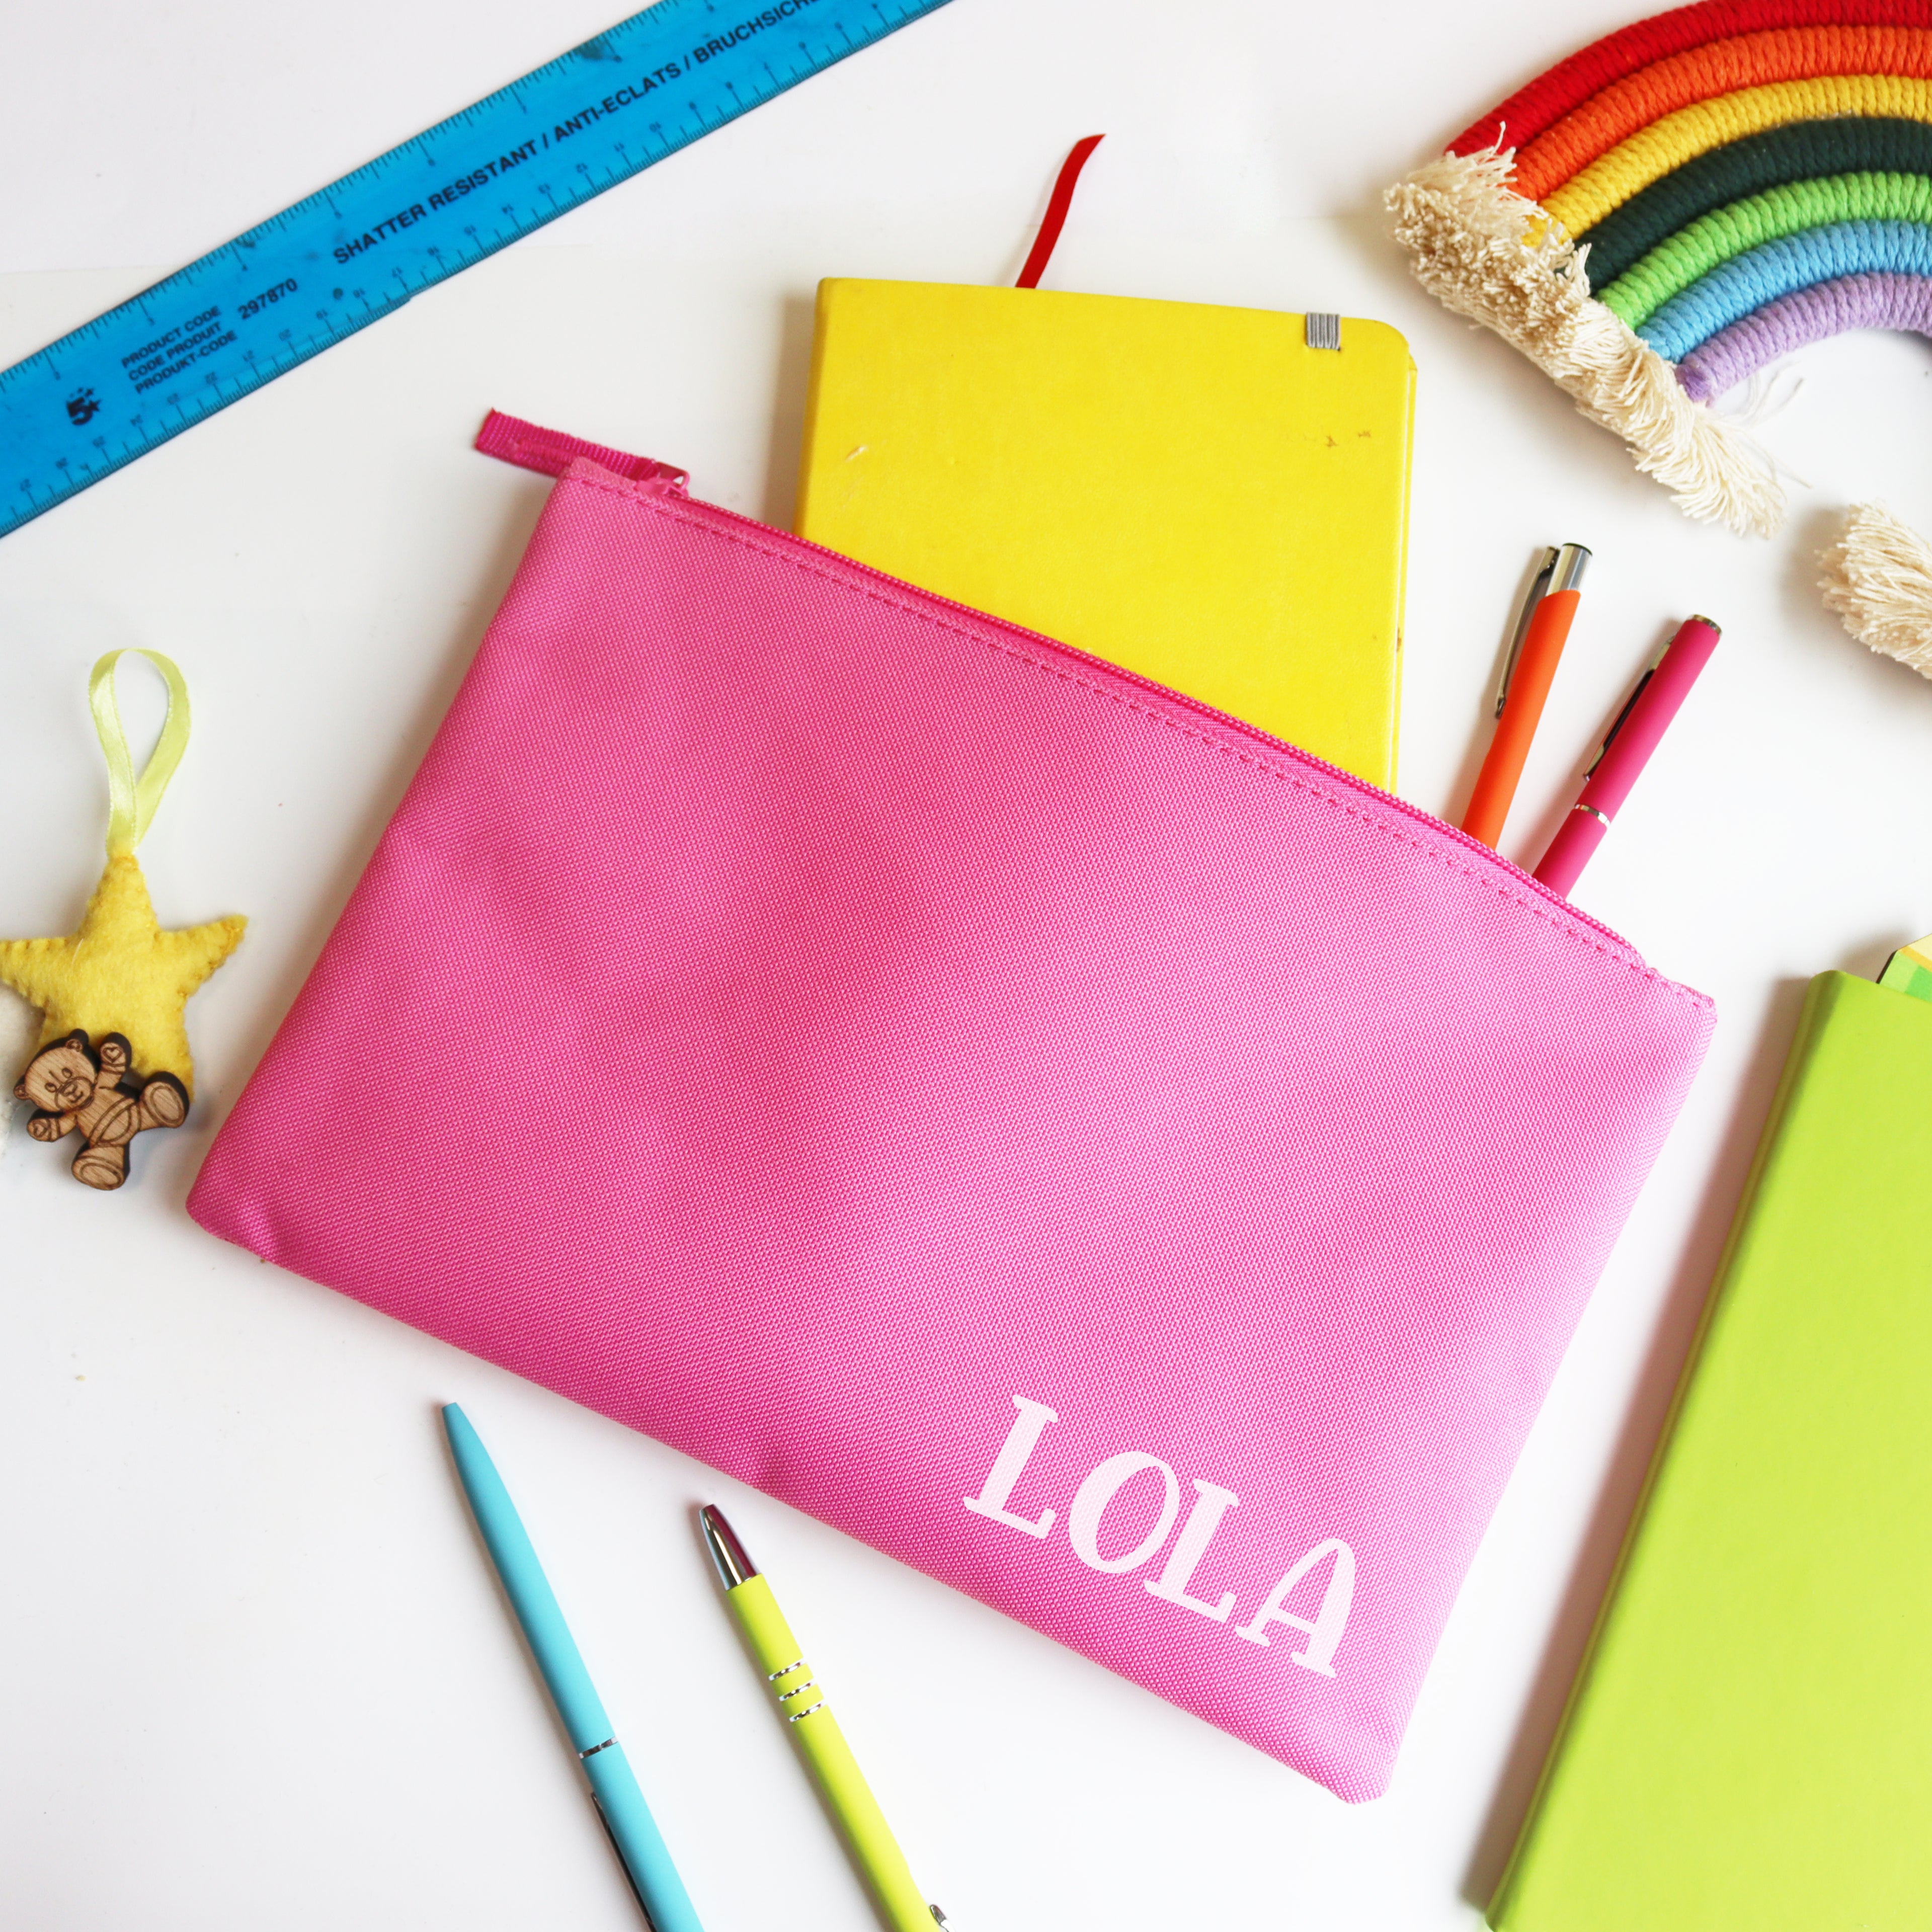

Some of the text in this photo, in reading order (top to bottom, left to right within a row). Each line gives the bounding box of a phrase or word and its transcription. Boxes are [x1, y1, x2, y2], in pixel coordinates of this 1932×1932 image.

[333, 0, 820, 264] SHATTER RESISTANT / ANTI-ECLATS / BRUCHSICH
[237, 278, 298, 319] 297870
[121, 305, 221, 368] PRODUCT CODE
[128, 321, 221, 381] CODE PRODUIT
[134, 330, 238, 394] PRODUKT-CODE
[963, 1394, 1356, 1678] LOLA
